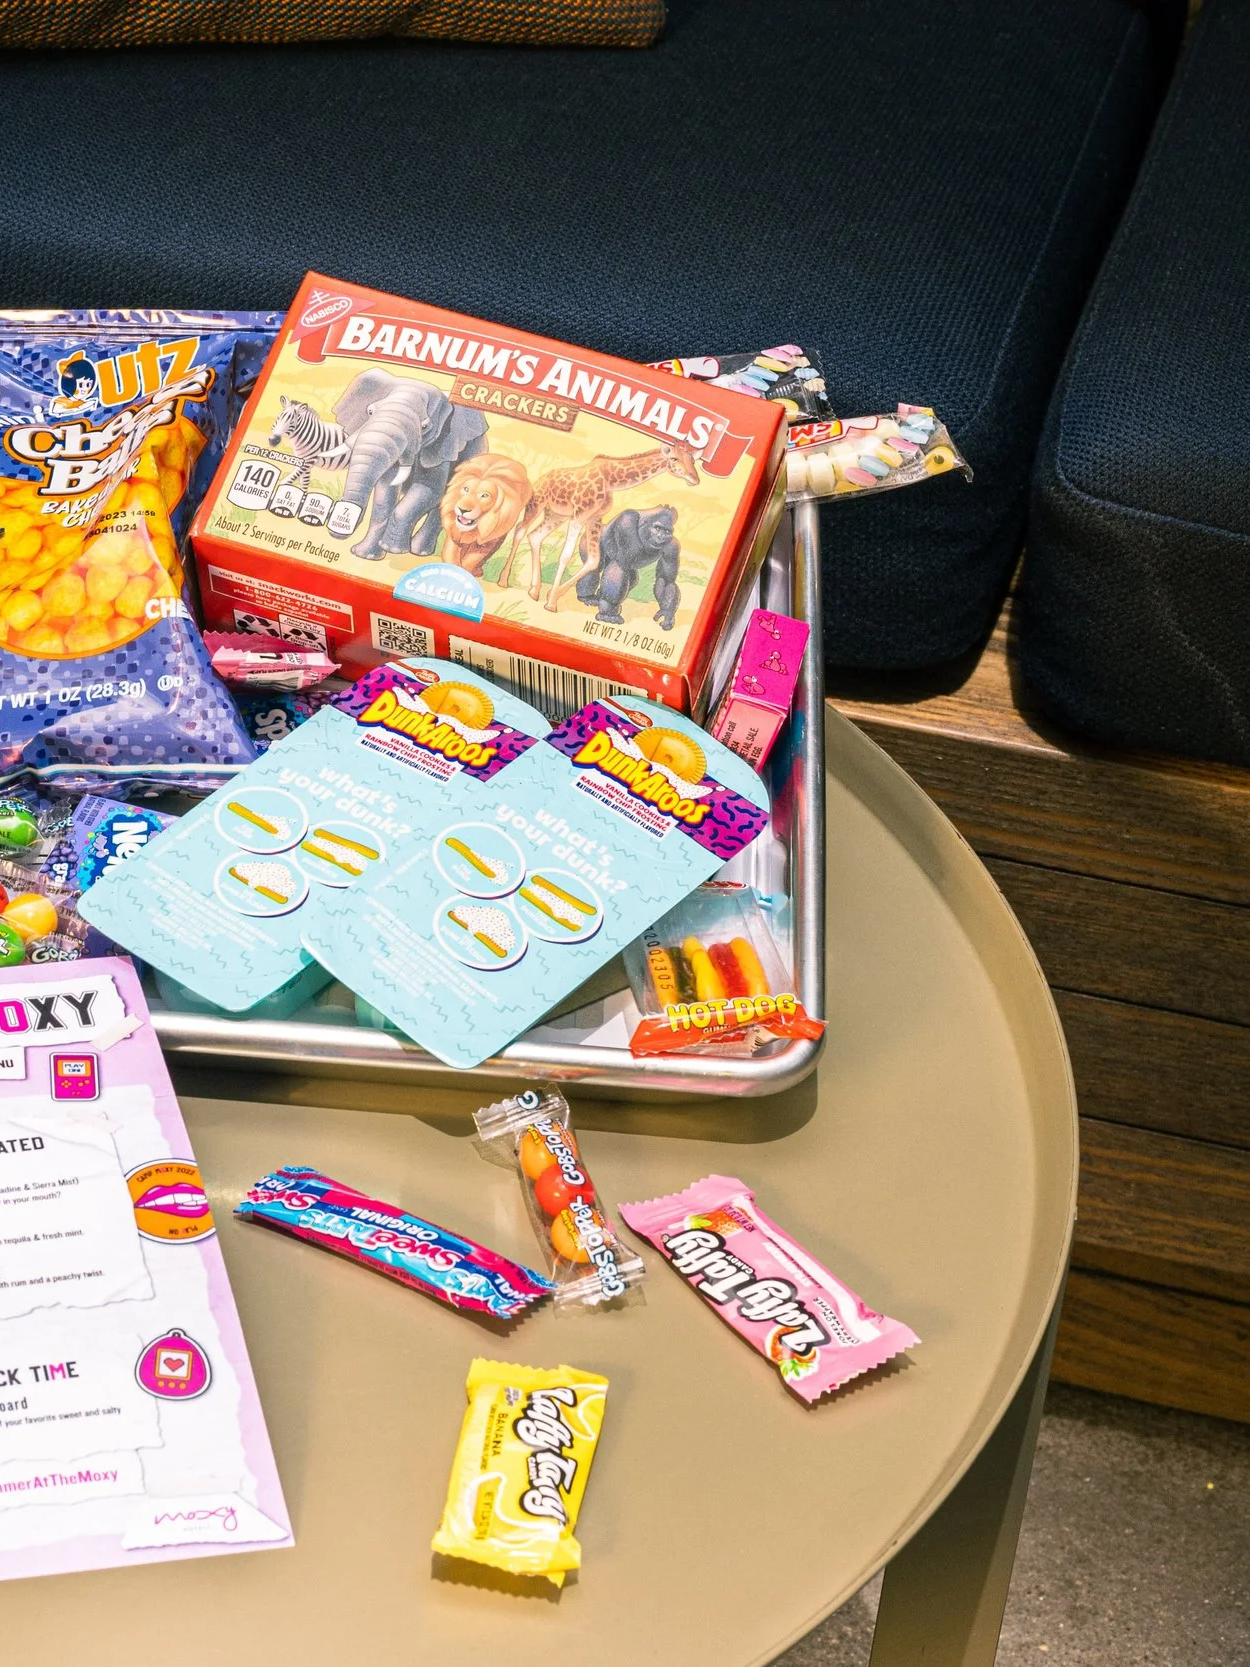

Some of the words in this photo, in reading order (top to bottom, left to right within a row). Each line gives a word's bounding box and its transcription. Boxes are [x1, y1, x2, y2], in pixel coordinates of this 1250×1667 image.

[304, 296, 350, 326] NABISCO
[338, 315, 538, 391] BARNUM'S
[540, 360, 715, 449] ANIMALS
[460, 382, 570, 423] CRACKERS
[245, 446, 258, 454] PER
[259, 448, 268, 457] 12
[269, 450, 305, 466] CRACKERS
[234, 482, 269, 500] CALORIES
[243, 465, 275, 488] 140
[215, 515, 241, 533] About
[241, 523, 249, 536] 2
[249, 524, 286, 548] Servings
[287, 539, 302, 553] per
[304, 542, 340, 563] Package
[245, 586, 318, 612] 1-800-622-4726
[258, 582, 341, 610] snackworks.com
[405, 579, 479, 610] CALCIUM
[583, 620, 599, 635] NET
[601, 624, 614, 638] WT
[614, 628, 621, 641] 2
[623, 629, 639, 646] 1/8
[640, 634, 654, 651] OZ
[654, 638, 675, 659] (60g)
[10, 692, 37, 708] WT
[44, 691, 52, 704] 1
[58, 687, 82, 704] OZ
[85, 678, 147, 702] (28.3g)
[357, 689, 498, 770] DunkAroos
[360, 739, 386, 757] NATURALLY
[396, 754, 427, 775] ARTIFICIALLY
[426, 768, 450, 783] FLAVORED
[365, 733, 400, 754] RAINBOW
[400, 748, 418, 762] CHIP
[417, 756, 453, 777] FROSTING
[390, 737, 419, 757] VANILLA
[419, 750, 451, 769] COOKIES
[319, 767, 397, 814] what's
[572, 730, 712, 826] DunkAroos
[278, 767, 338, 802] your
[335, 797, 412, 839] dunk?
[576, 782, 602, 803] NATURALLY
[611, 800, 641, 827] ARTIFICIALLY
[640, 820, 665, 838] FLAVORED
[580, 775, 616, 799] RAINBOW
[615, 796, 633, 811] CHIP
[633, 805, 668, 832] FROSTING
[605, 782, 634, 803] VANILLA
[634, 797, 666, 822] COOKIES
[495, 803, 553, 847] your
[552, 840, 628, 894] dunk?
[534, 808, 613, 868] what's
[666, 1000, 730, 1032] HOT
[732, 994, 797, 1023] DOG
[13, 1196, 30, 1204] your
[31, 1191, 62, 1202] mouth?
[32, 1181, 57, 1189] Sierra
[58, 1177, 79, 1187] Mist)
[4, 1235, 31, 1245] tequila
[42, 1231, 63, 1240] fresh
[64, 1229, 85, 1237] mint.
[350, 1204, 440, 1242] ORIGINAL
[570, 1195, 626, 1298] GOBSTOPPER
[665, 1229, 751, 1303] Taffy
[726, 1254, 754, 1274] CANDY
[29, 1277, 44, 1285] and
[52, 1273, 81, 1283] peachy
[83, 1270, 105, 1278] twist.
[736, 1278, 826, 1353] Laffy
[29, 1361, 79, 1383] TIME
[4, 1418, 23, 1428] your
[25, 1414, 57, 1425] favorite
[59, 1411, 82, 1421] sweet
[85, 1409, 100, 1418] and
[102, 1405, 122, 1416] salty
[492, 1412, 509, 1457] BANANA
[516, 1387, 577, 1456] Laffy
